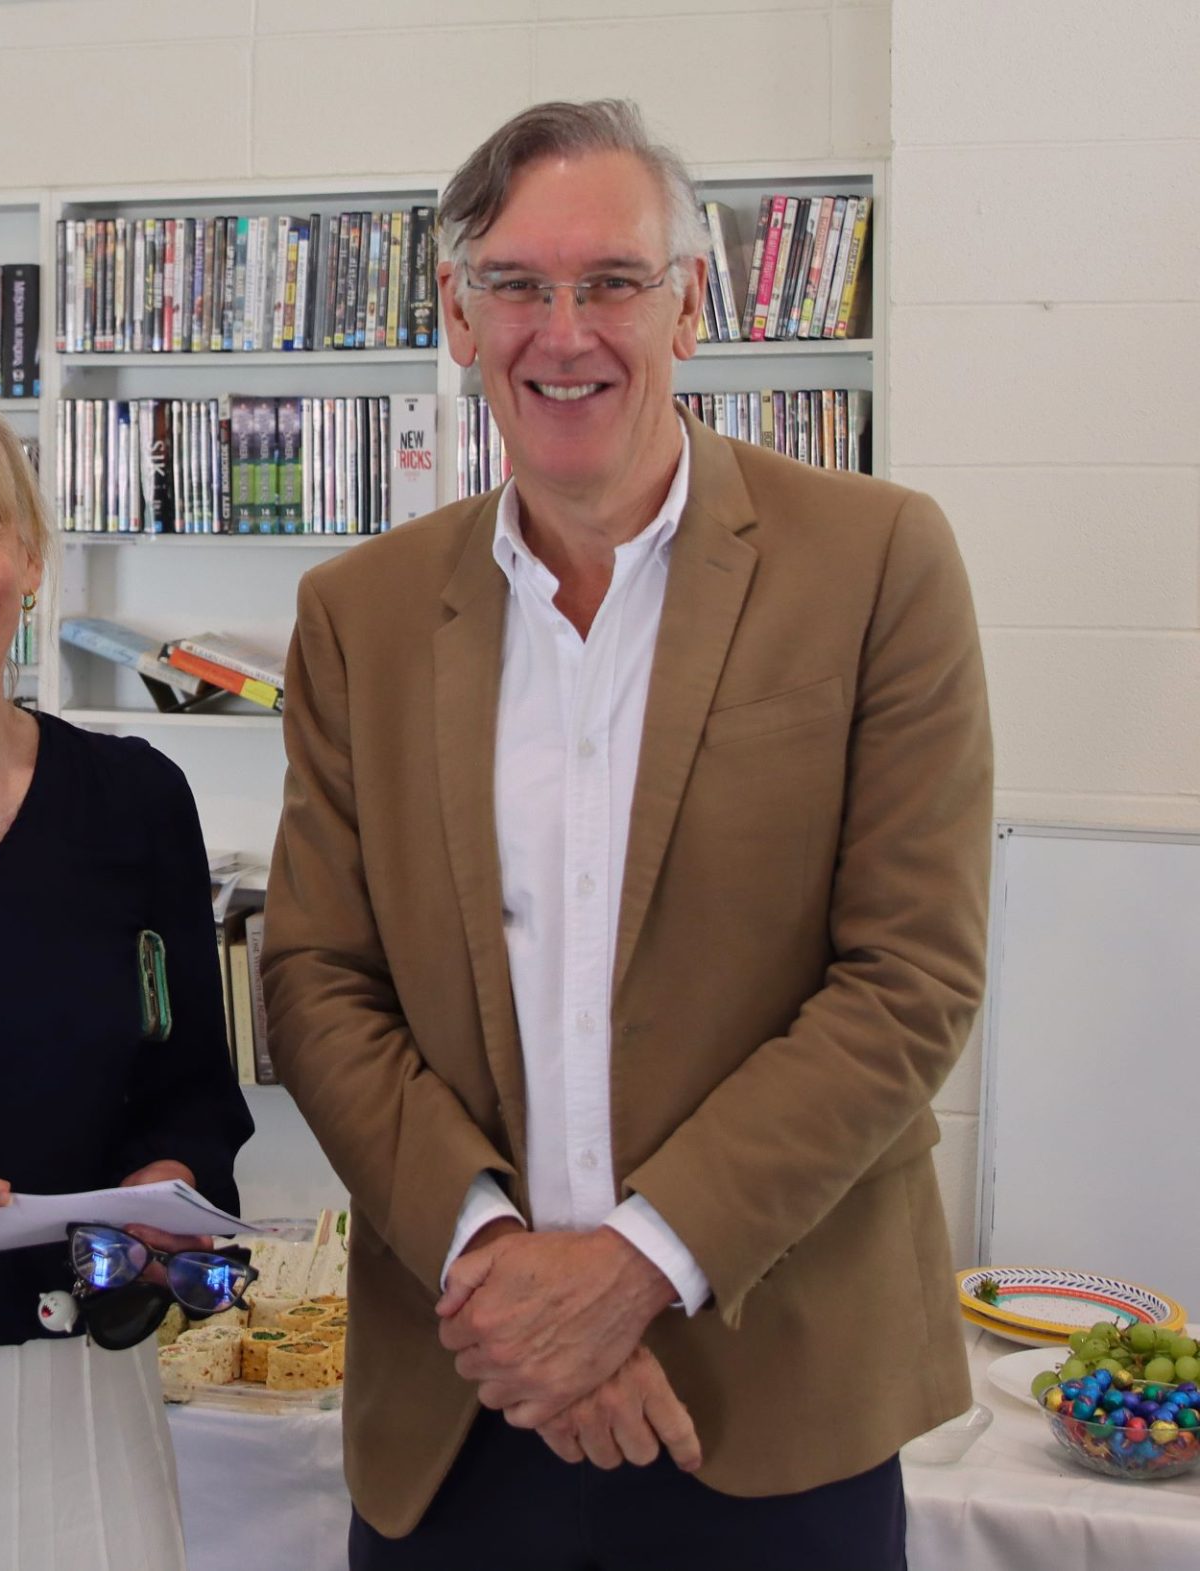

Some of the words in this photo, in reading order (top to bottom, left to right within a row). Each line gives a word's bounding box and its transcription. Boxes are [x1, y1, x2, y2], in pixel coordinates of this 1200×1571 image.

[400, 430, 424, 450] NEW
[394, 449, 432, 470] TRICKS
[221, 496, 231, 519] CITY
